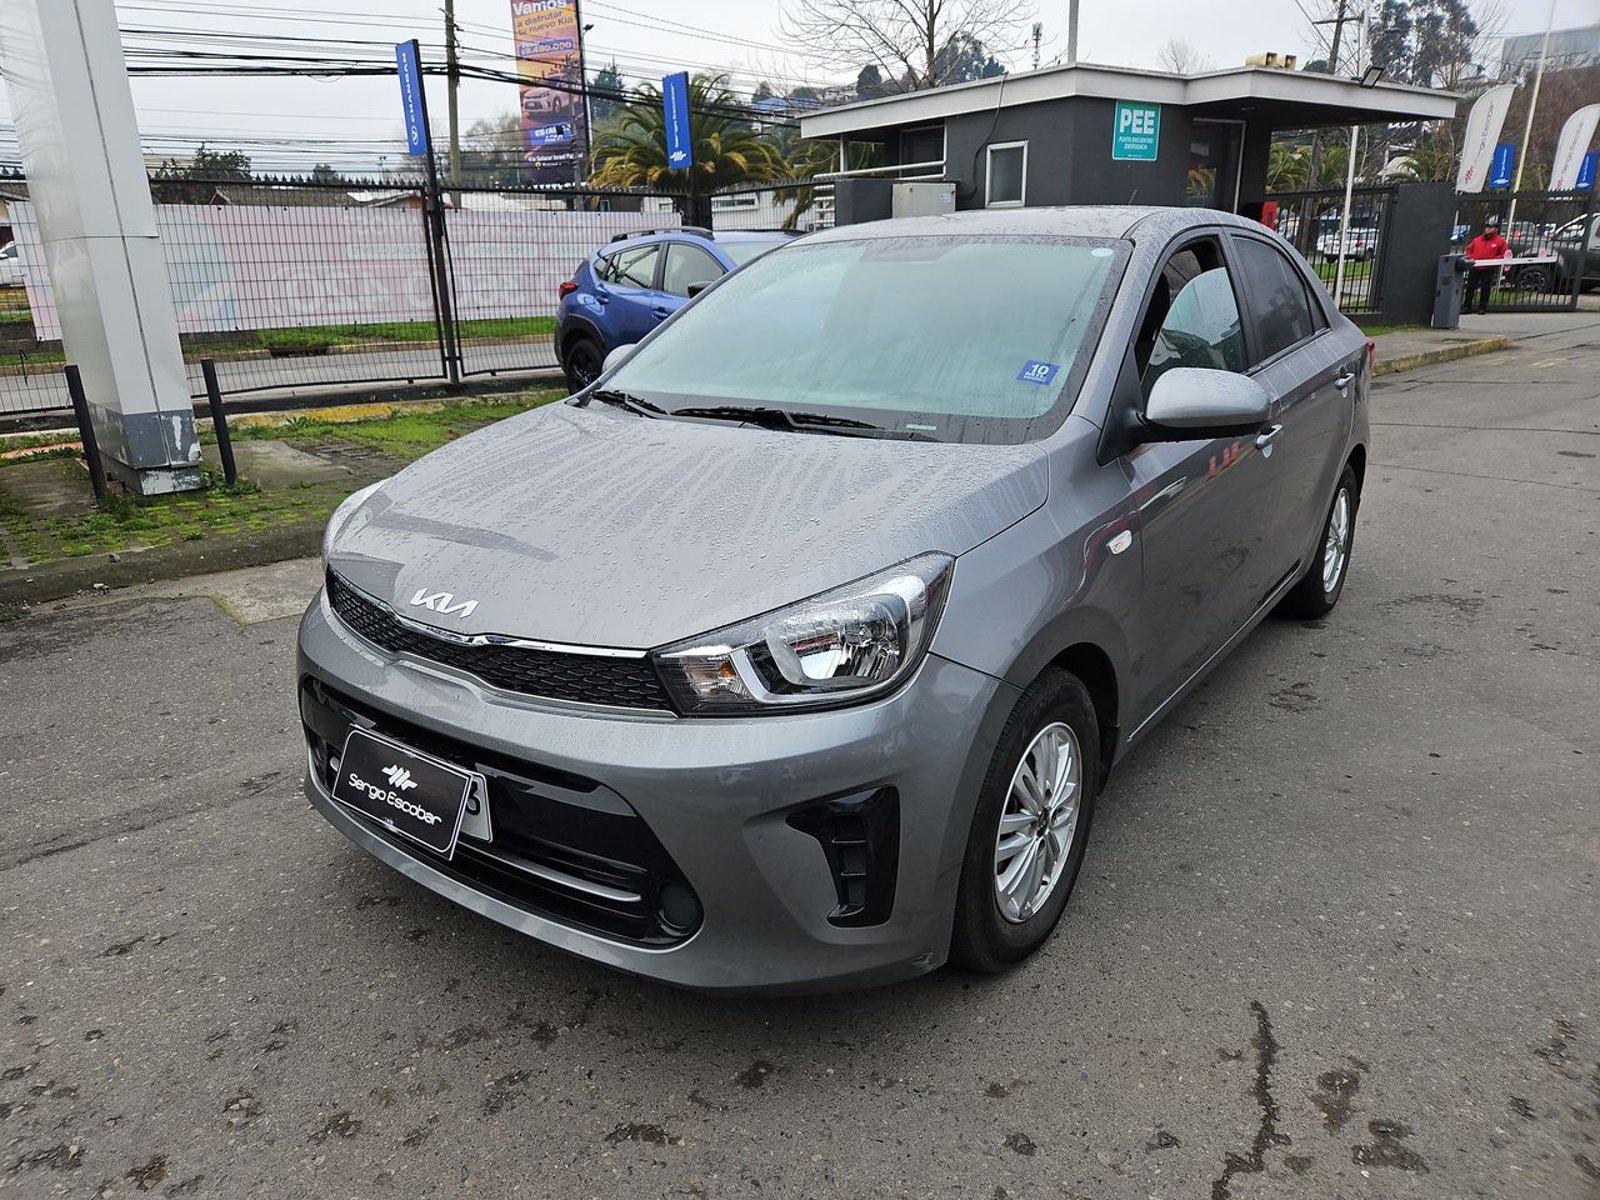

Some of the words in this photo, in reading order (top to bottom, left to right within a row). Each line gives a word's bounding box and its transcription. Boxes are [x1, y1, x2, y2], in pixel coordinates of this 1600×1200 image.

[513, 0, 567, 15] Vamos
[525, 11, 563, 25] disfrutar
[529, 21, 556, 32] nuevo
[558, 17, 573, 26] Kia
[1119, 108, 1156, 135] PEE
[1031, 363, 1050, 377] 10
[409, 587, 481, 620] KIA
[348, 772, 387, 800] Sergo
[386, 790, 443, 827] Escobar
